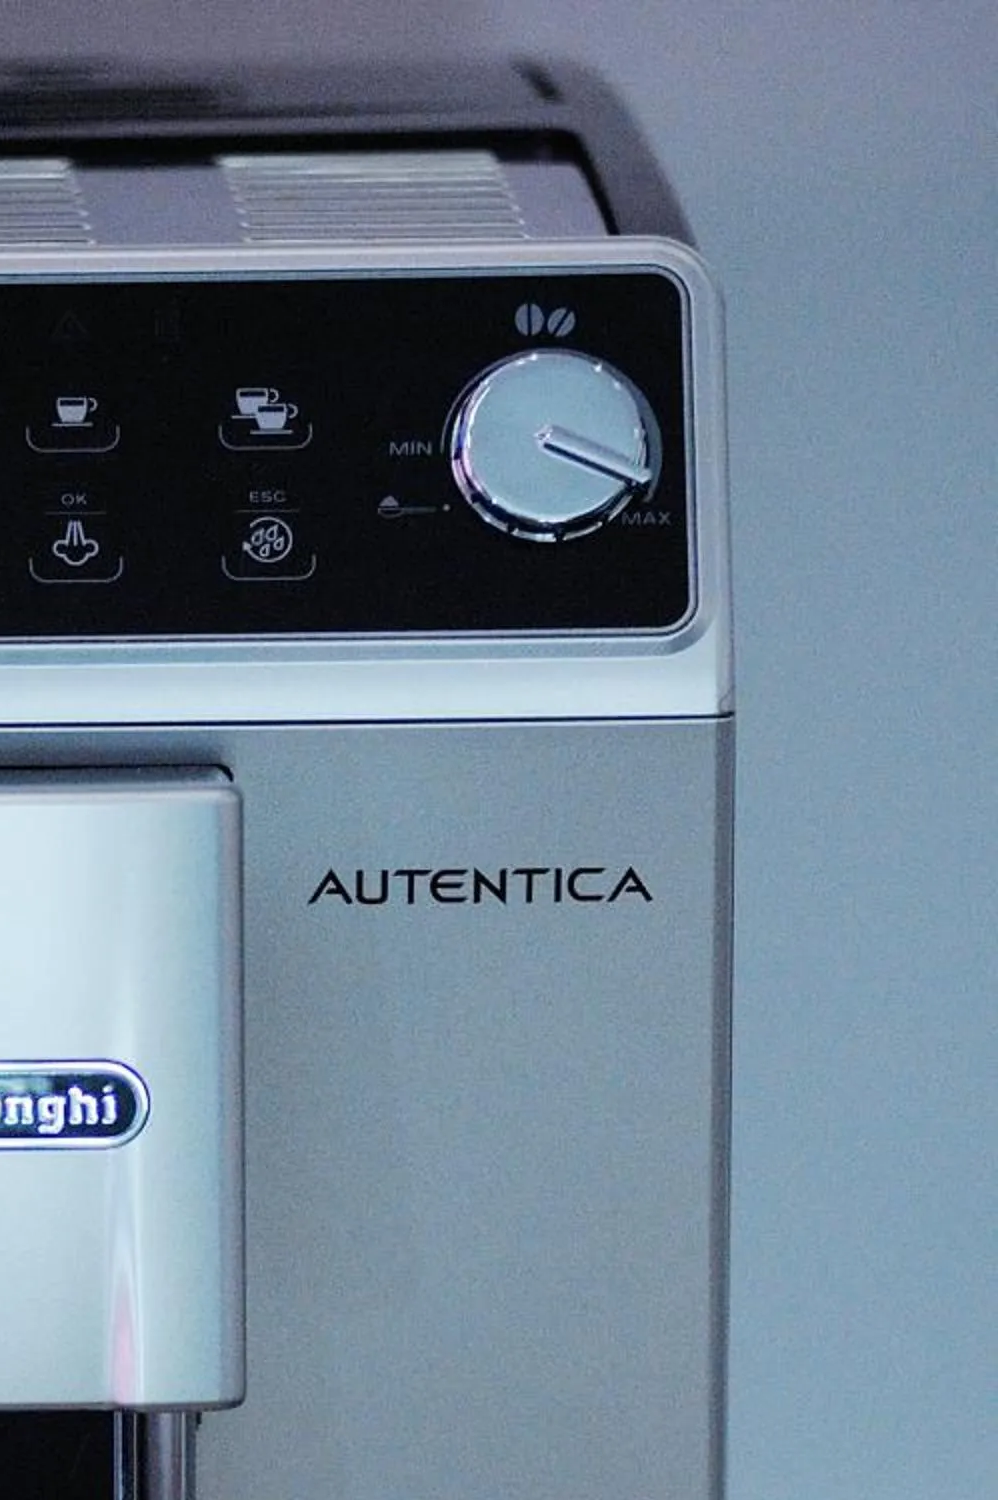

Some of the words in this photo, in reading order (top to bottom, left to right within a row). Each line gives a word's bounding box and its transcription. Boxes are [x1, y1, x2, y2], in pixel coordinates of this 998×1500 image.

[389, 440, 432, 456] MIN
[60, 492, 87, 507] OK
[249, 490, 287, 503] ESC
[621, 511, 672, 526] MAX
[308, 867, 653, 905] AUTENTICA
